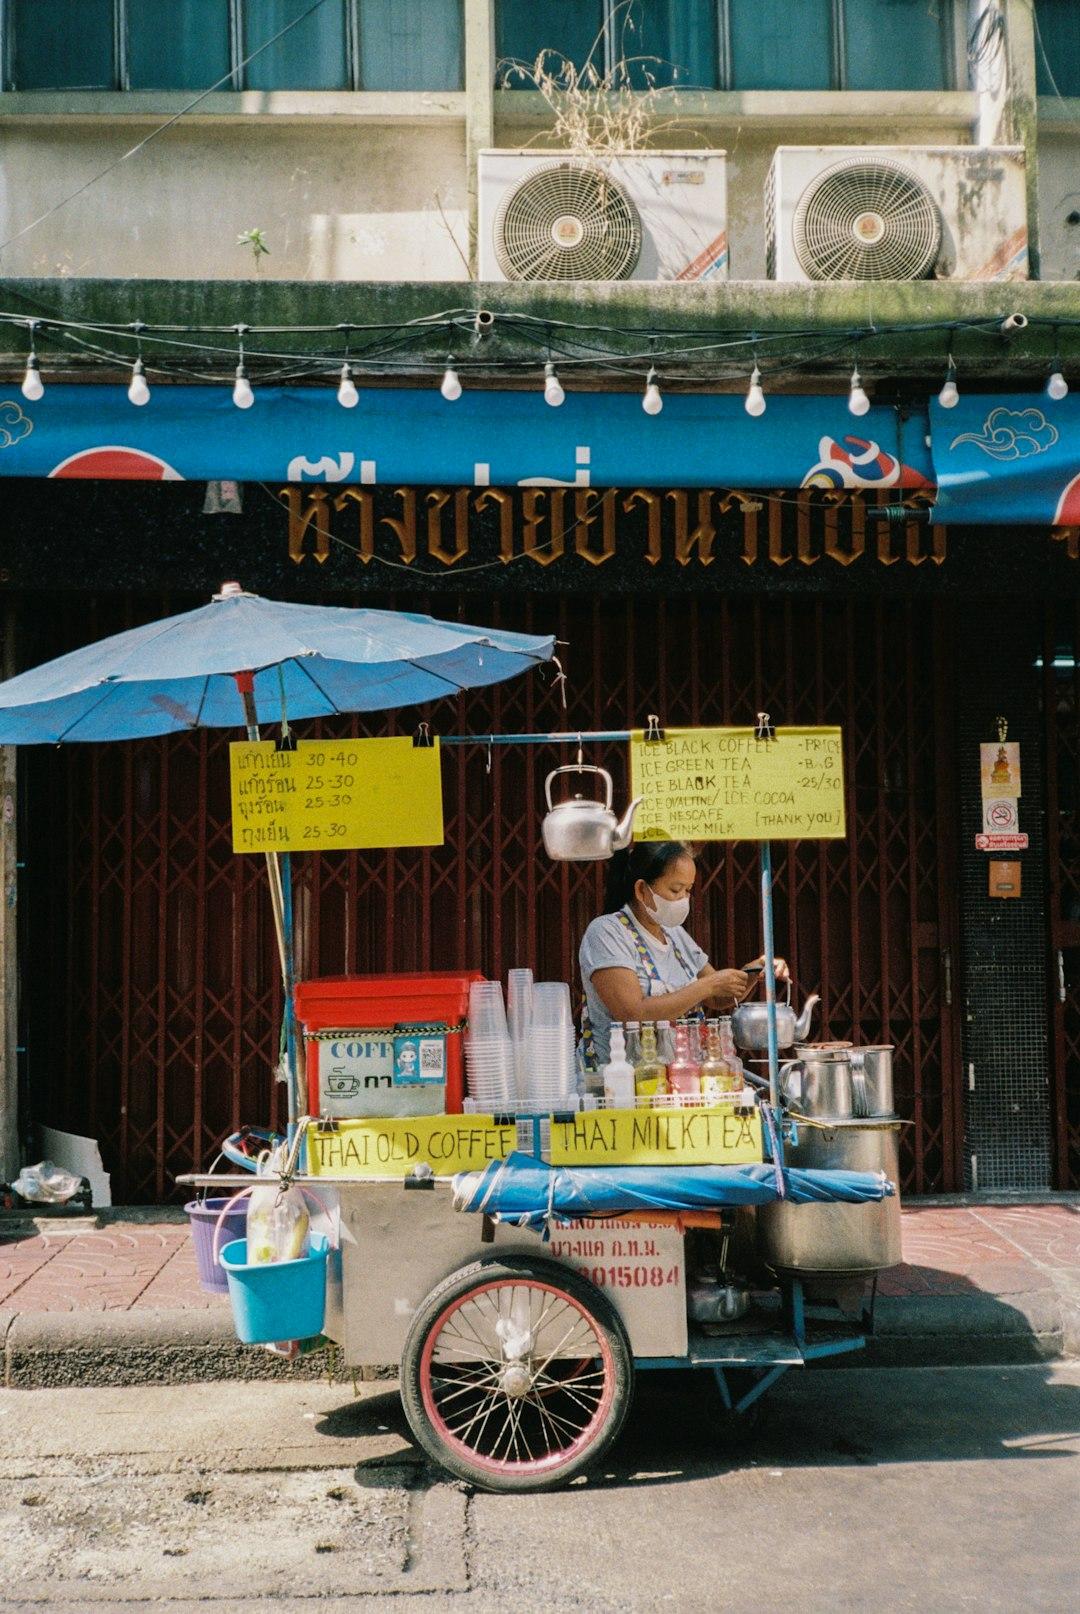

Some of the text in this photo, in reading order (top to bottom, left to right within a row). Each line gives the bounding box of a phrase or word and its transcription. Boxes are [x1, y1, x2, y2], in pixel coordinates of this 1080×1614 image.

[640, 738, 773, 757] ICE BLACK COFFEE
[640, 756, 752, 778] ICE GREEN TEA
[306, 774, 355, 790] 25-30
[641, 780, 664, 795] ICE
[722, 773, 752, 789] TEA
[304, 794, 352, 809] 25-30
[640, 797, 663, 810] ICE
[724, 790, 750, 805] ICE
[754, 791, 795, 805] COCOA
[640, 808, 724, 824] ICE NESCAFE
[303, 822, 348, 838] 25-30
[669, 824, 700, 836] PINK
[704, 823, 735, 836] MILK
[560, 1114, 756, 1151] THAI MILK TEA
[314, 1129, 513, 1168] THAI OLD COFFEE
